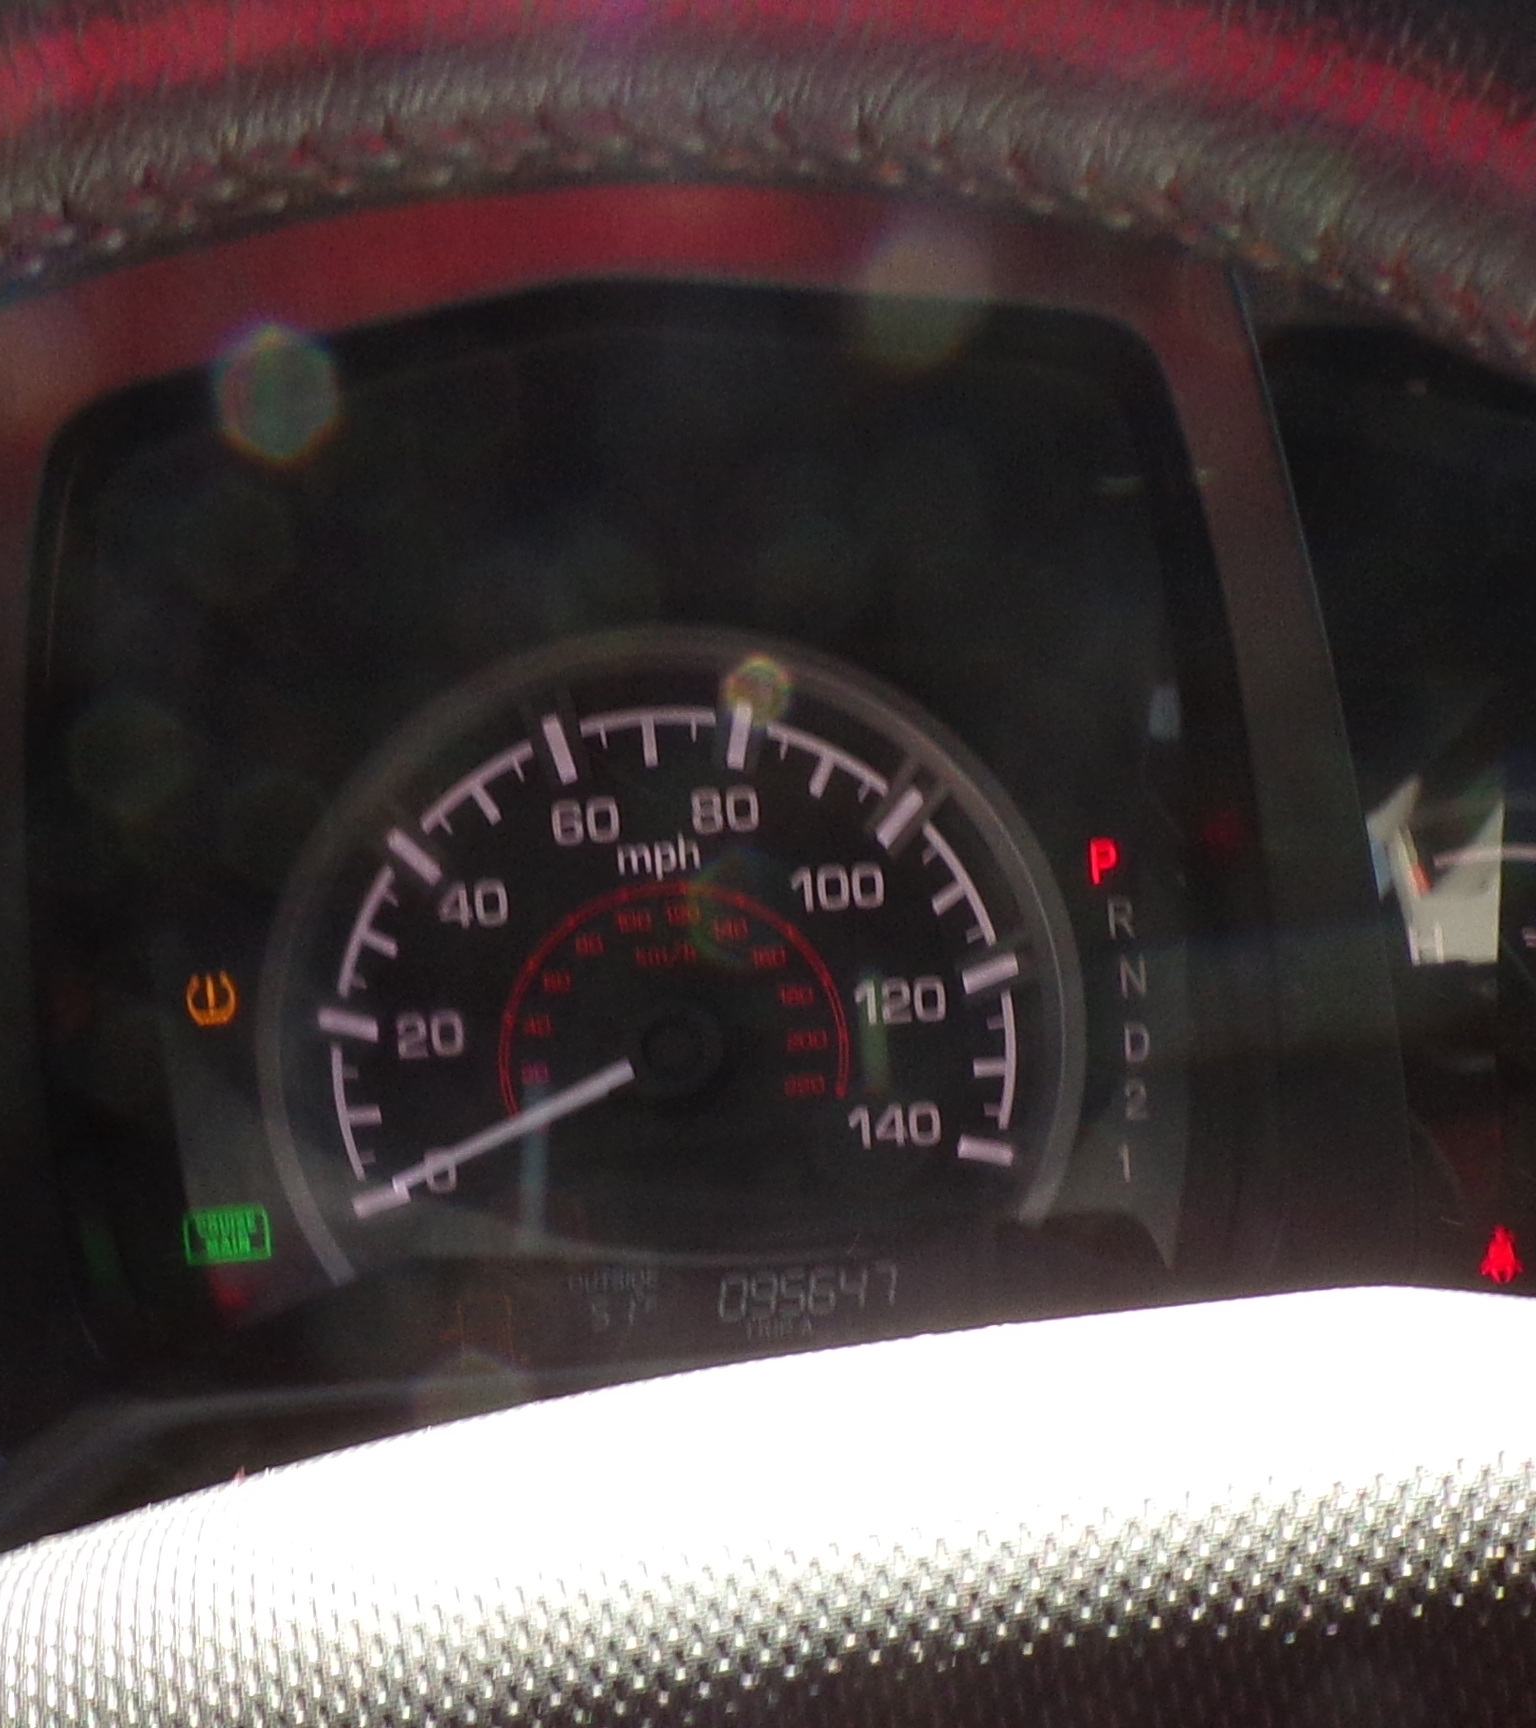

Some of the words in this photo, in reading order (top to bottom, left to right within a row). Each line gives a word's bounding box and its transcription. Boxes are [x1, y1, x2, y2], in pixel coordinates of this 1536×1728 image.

[551, 796, 621, 846] 60
[691, 784, 760, 835] 80
[616, 830, 701, 882] mph
[1088, 836, 1119, 885] P
[438, 876, 509, 929] 40
[791, 861, 885, 913] 100
[1107, 895, 1136, 940] R
[854, 973, 946, 1026] 120
[1120, 953, 1147, 999] N
[396, 1007, 464, 1060] 20
[1124, 1022, 1150, 1063] D
[848, 1101, 942, 1150] 140
